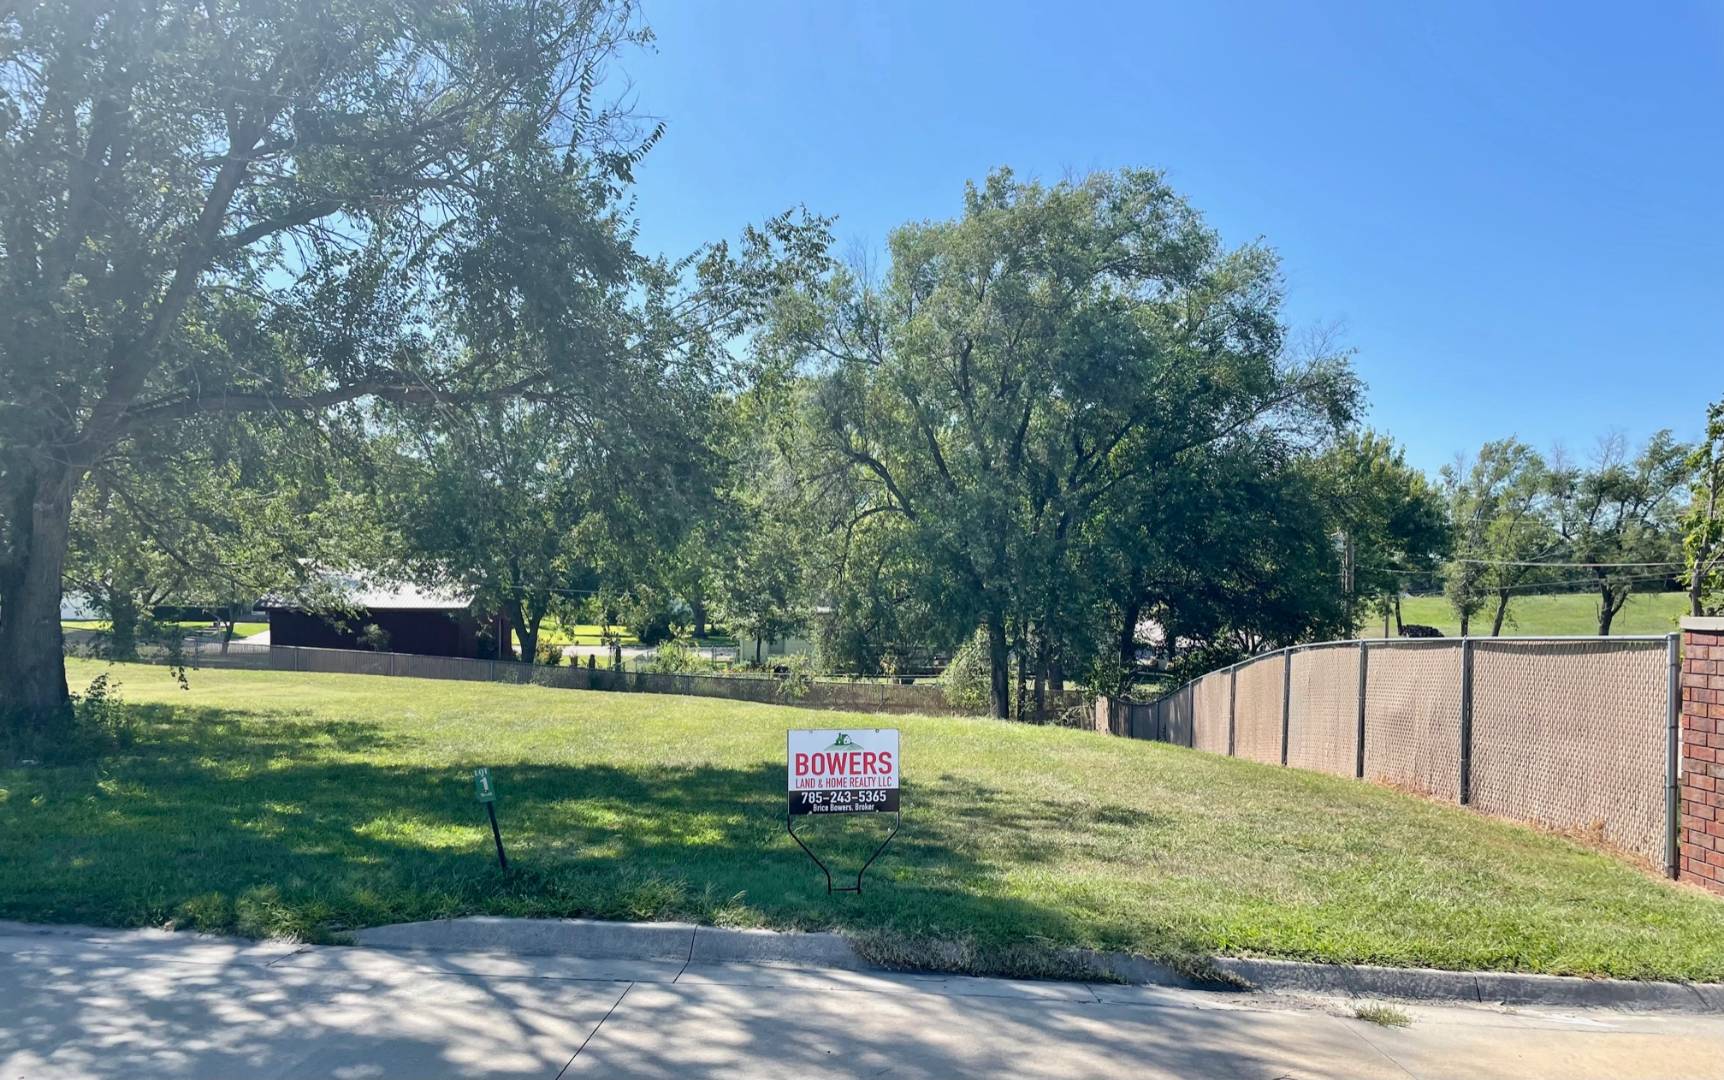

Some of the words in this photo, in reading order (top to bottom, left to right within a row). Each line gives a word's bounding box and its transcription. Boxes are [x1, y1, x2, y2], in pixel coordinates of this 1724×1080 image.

[795, 751, 892, 776] BOWERS
[795, 777, 816, 789] LAND
[818, 778, 823, 788] &
[825, 777, 848, 788] HOME
[849, 776, 877, 788] REALTY
[878, 776, 893, 787] LLC
[801, 790, 887, 804] 785-243-5365
[813, 804, 829, 812] Brice
[855, 803, 875, 811] Broker
